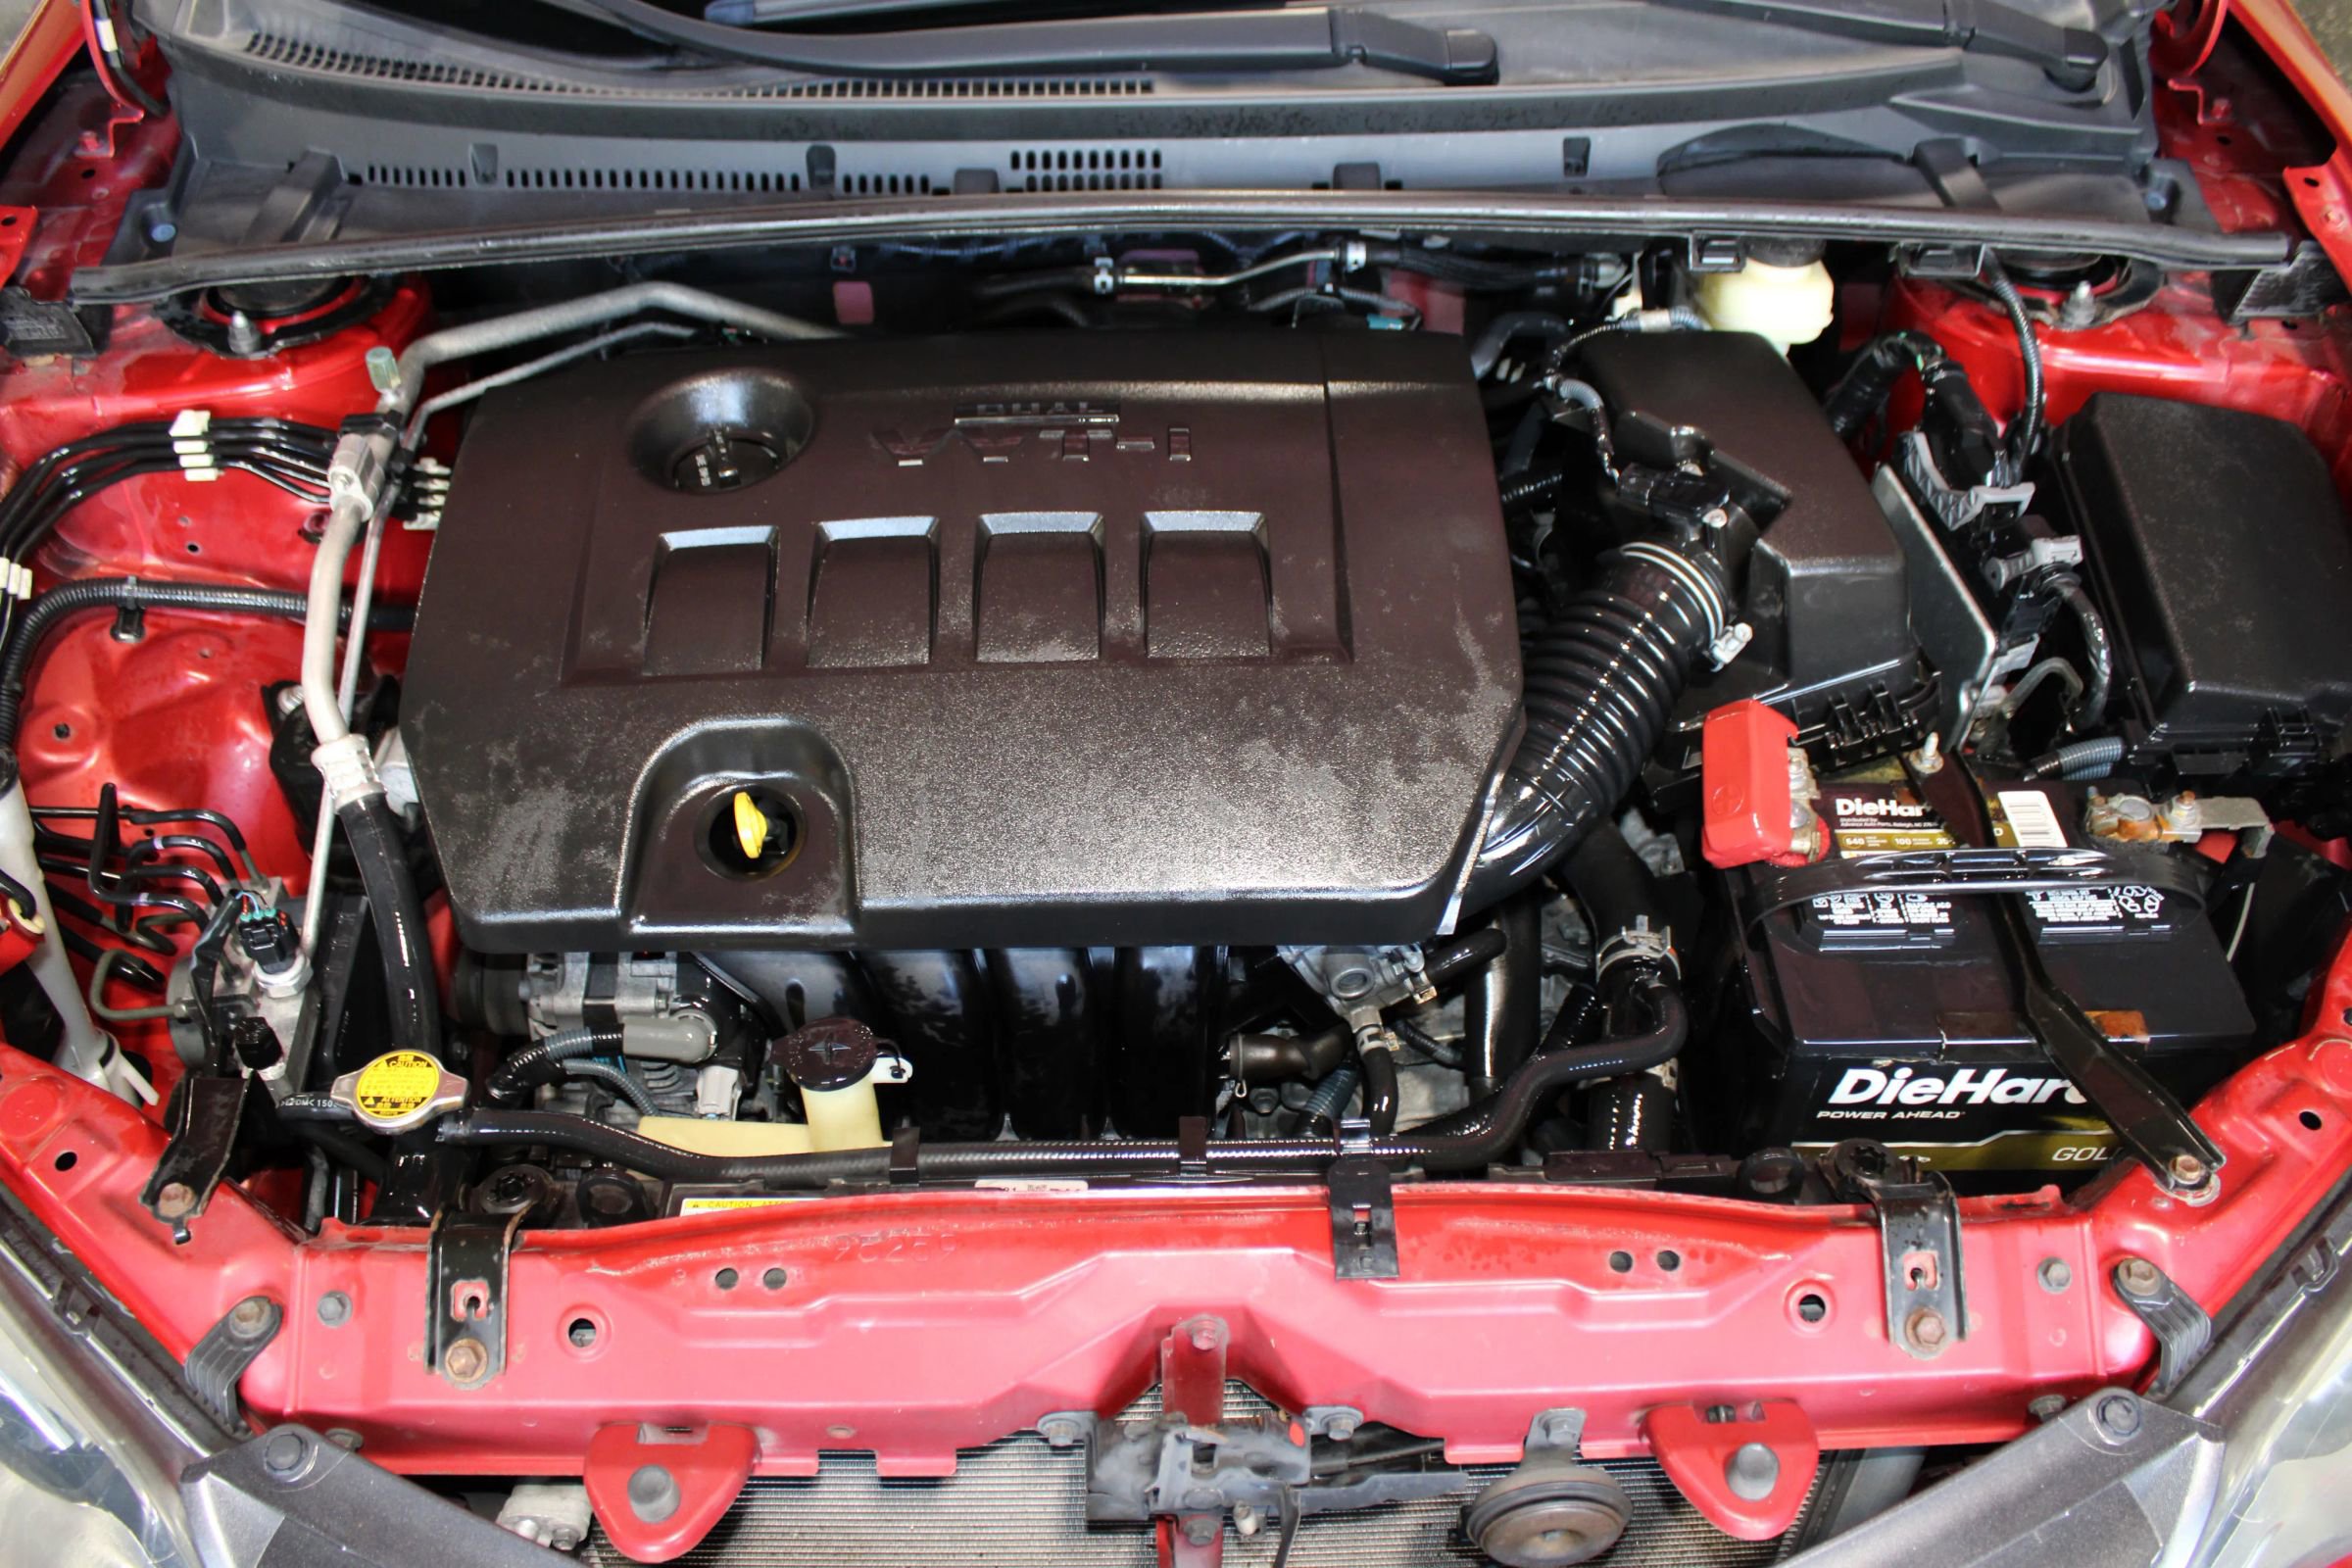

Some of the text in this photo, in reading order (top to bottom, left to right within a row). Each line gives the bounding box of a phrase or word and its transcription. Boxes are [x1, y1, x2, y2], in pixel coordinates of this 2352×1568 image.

[1835, 798, 1929, 817] DieHar
[1817, 1110, 1962, 1120] POWER AHEAD
[2051, 1147, 2114, 1162] GOL
